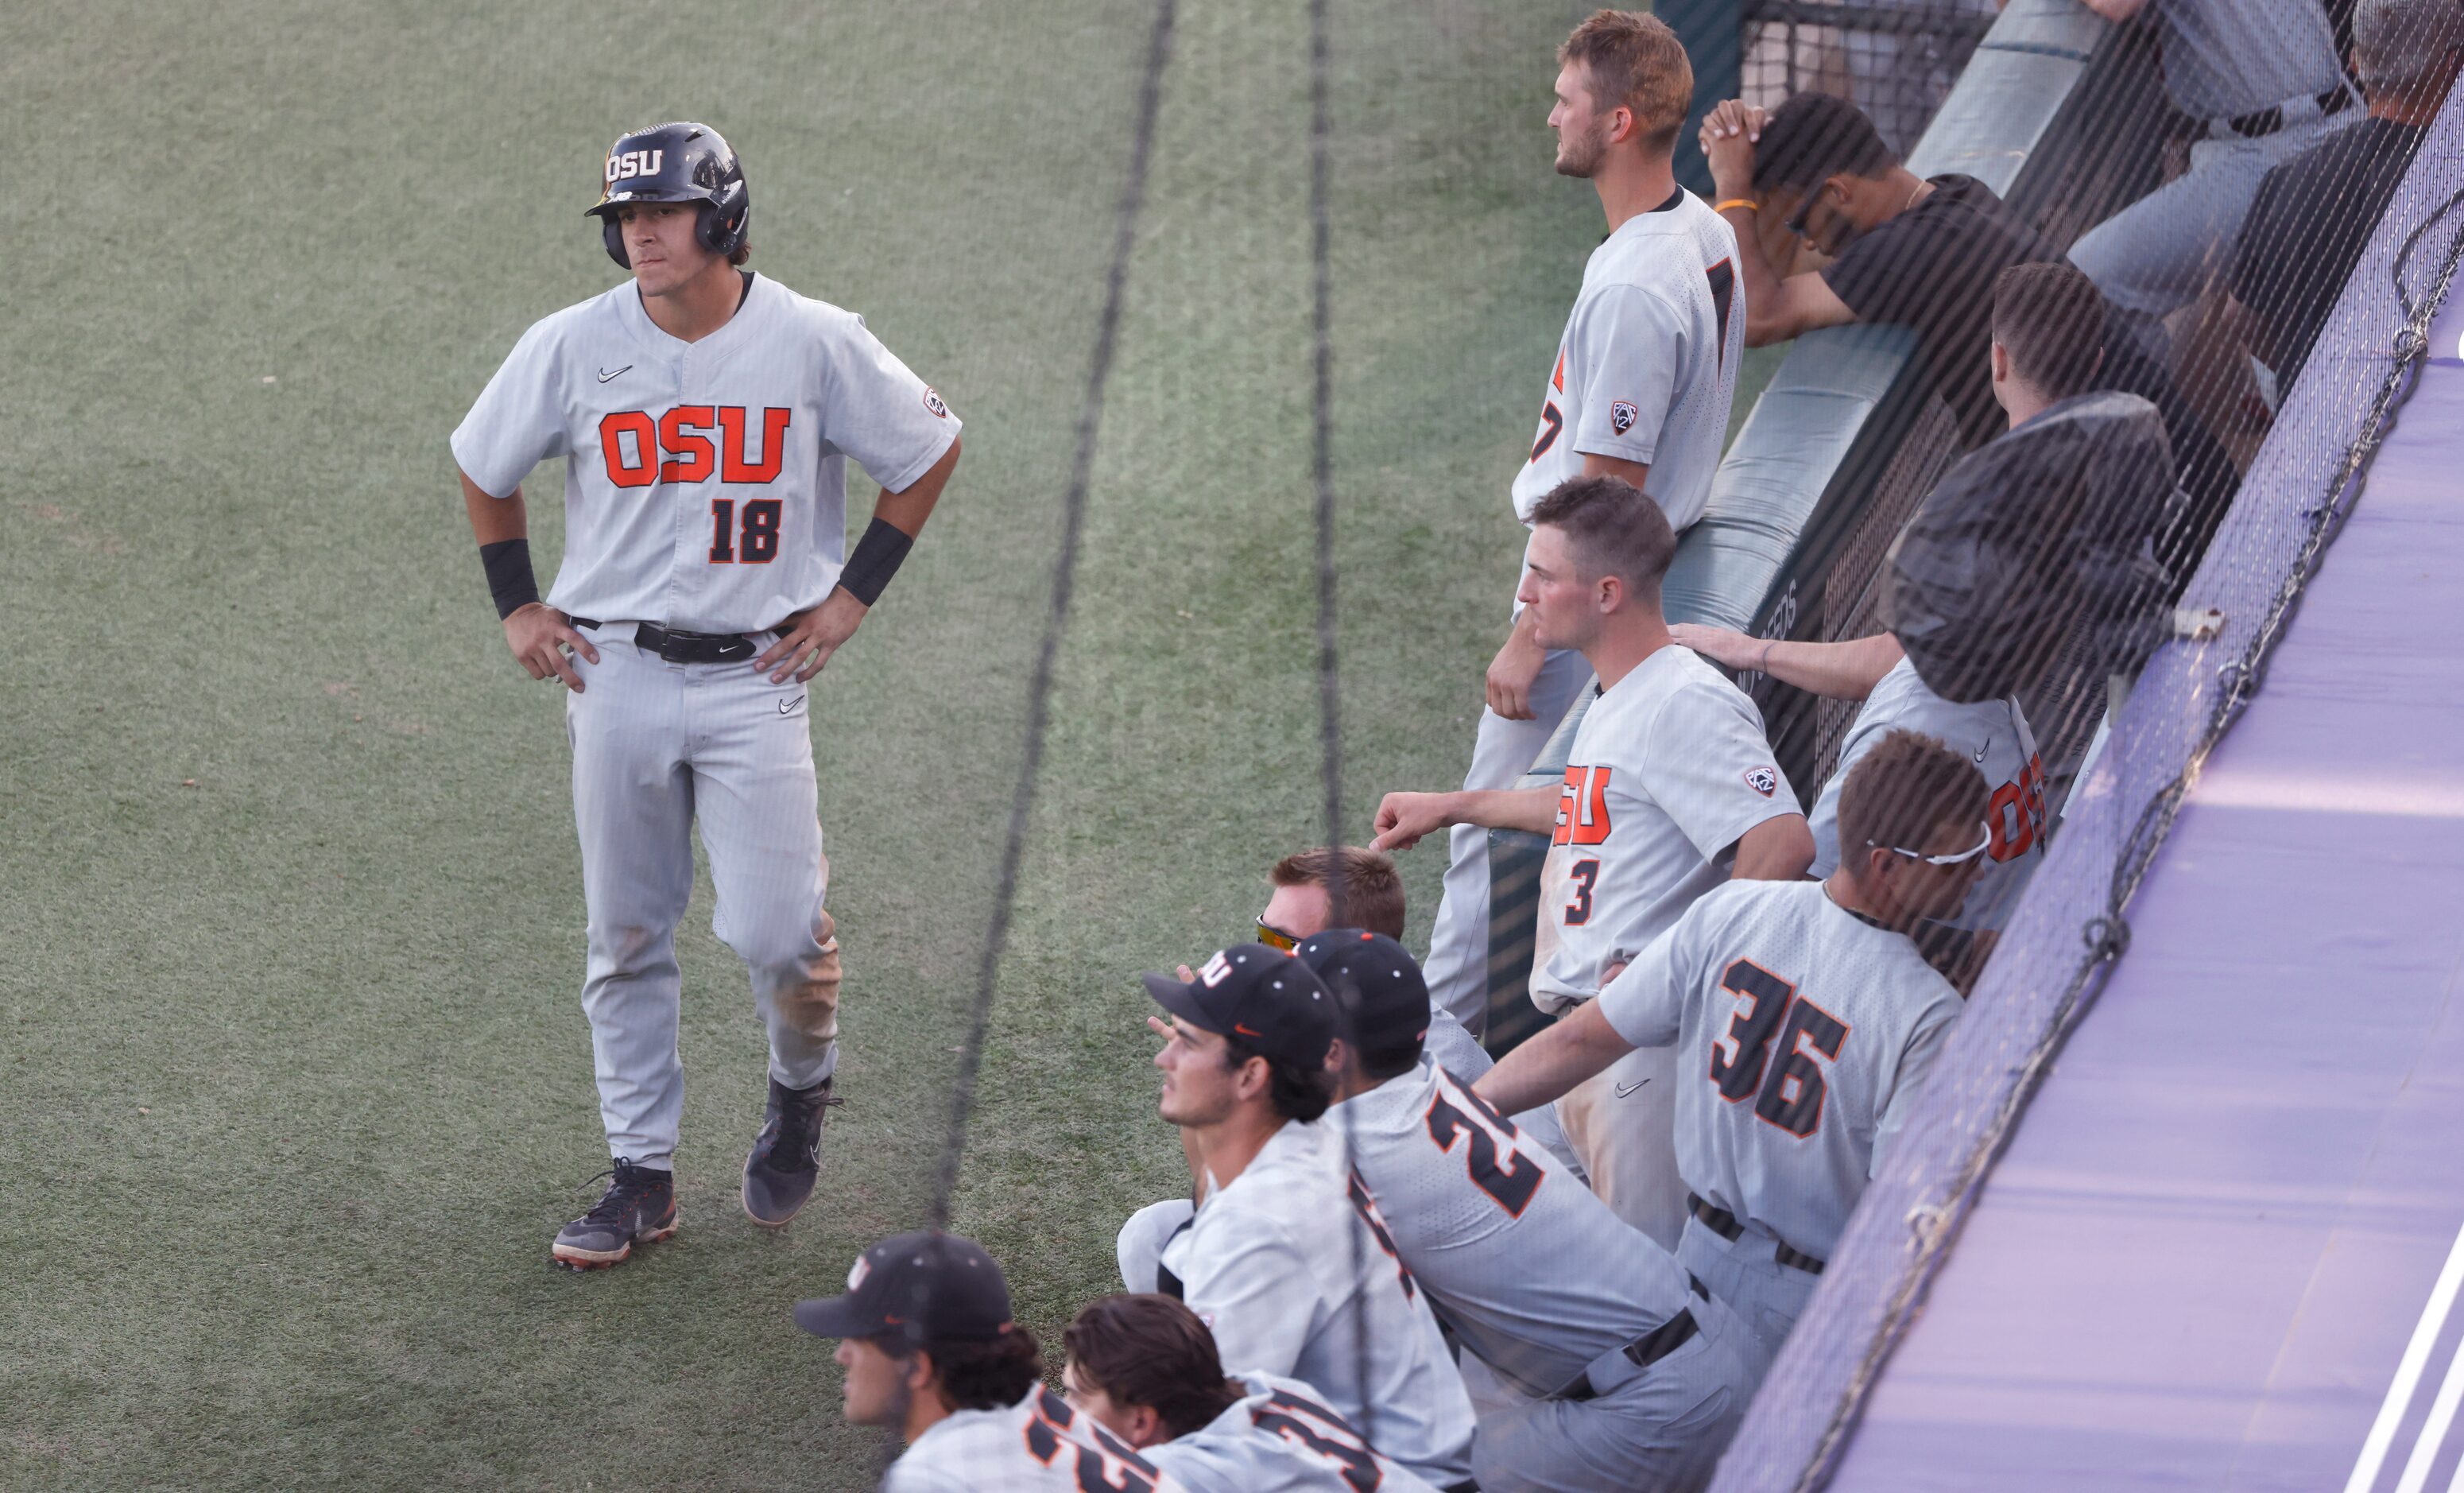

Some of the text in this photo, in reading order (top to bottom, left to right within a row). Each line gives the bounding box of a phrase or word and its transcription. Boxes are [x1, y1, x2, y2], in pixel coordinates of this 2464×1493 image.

[606, 149, 663, 184] OSU
[1614, 402, 1636, 425] PAC
[1615, 416, 1629, 429] 12
[599, 405, 791, 488] OSU
[709, 498, 783, 563] 18
[1552, 764, 1612, 847] SU
[1745, 768, 1774, 787] PAC
[1757, 779, 1773, 791] 12
[1988, 750, 2046, 863] OS
[1564, 859, 1600, 925] 3
[1709, 956, 1852, 1139] 36
